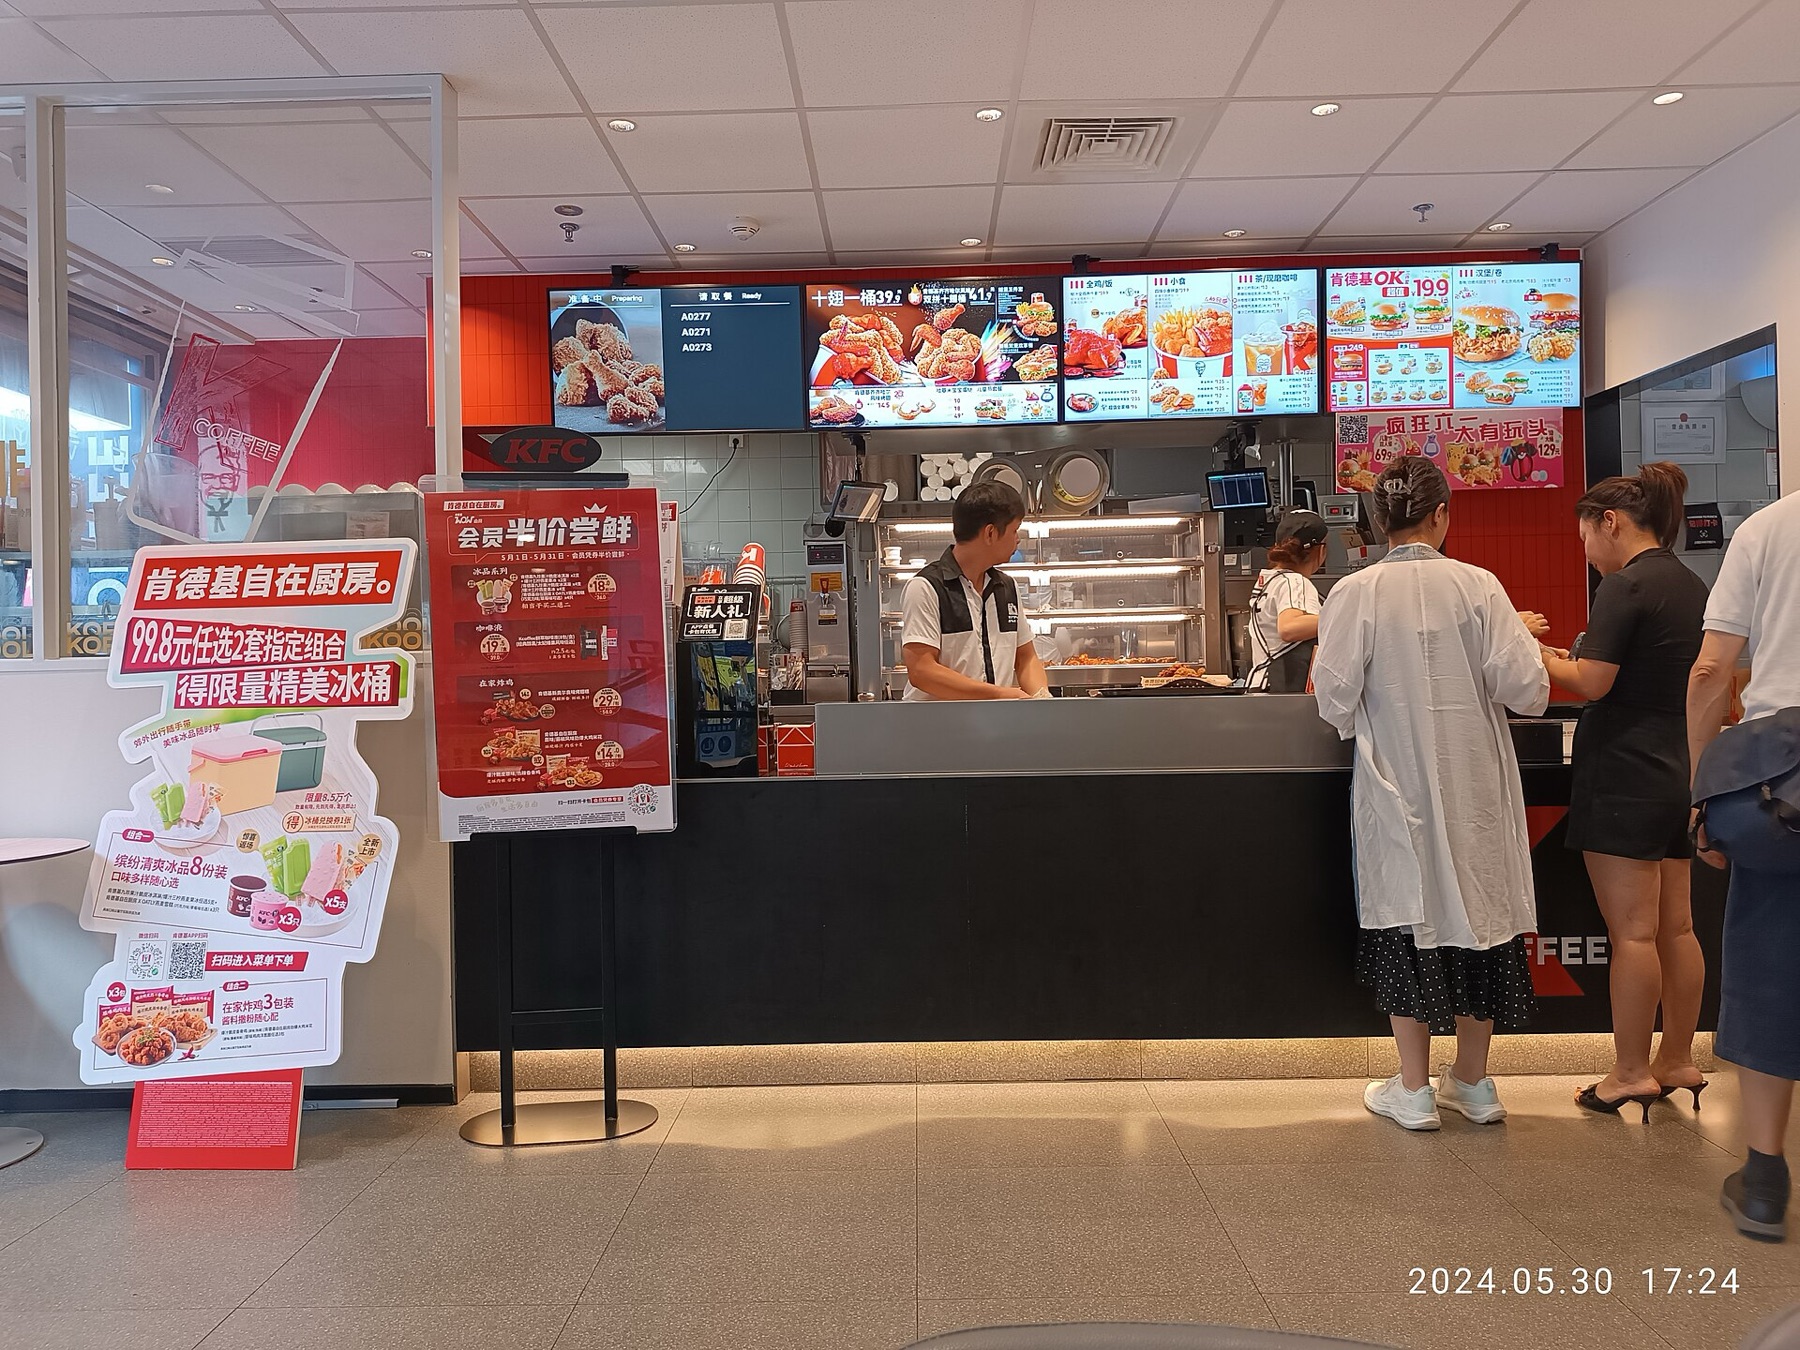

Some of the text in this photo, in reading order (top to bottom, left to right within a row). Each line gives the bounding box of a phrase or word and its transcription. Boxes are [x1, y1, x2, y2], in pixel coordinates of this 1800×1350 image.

[1330, 272, 1372, 287] 肯德基
[611, 294, 644, 303] Preparing
[742, 292, 762, 301] Ready
[811, 289, 875, 307] 十翅一桶
[681, 312, 711, 322] A0277
[681, 328, 711, 337] A0271
[682, 343, 713, 352] A0273
[1386, 412, 1478, 435] 疯狂六一
[1454, 418, 1548, 444] 大有玩头
[192, 417, 281, 463] COFFEE
[504, 438, 589, 464] KFC
[457, 515, 633, 549] 会员半价尝鲜
[143, 562, 392, 602] 肯德基自在厨房。
[693, 604, 744, 619] 新人礼
[130, 618, 346, 666] 99.8元任选2套指定组合
[177, 660, 392, 707] 得限量精美冰桶
[304, 792, 353, 803] 限量8.5万个
[114, 853, 228, 880] 缤纷清爽冰品8份装
[111, 871, 179, 889] 口味多样随心选
[210, 954, 294, 967] 扫码进入菜单下单
[222, 993, 295, 1014] 在家炸鸡3包装
